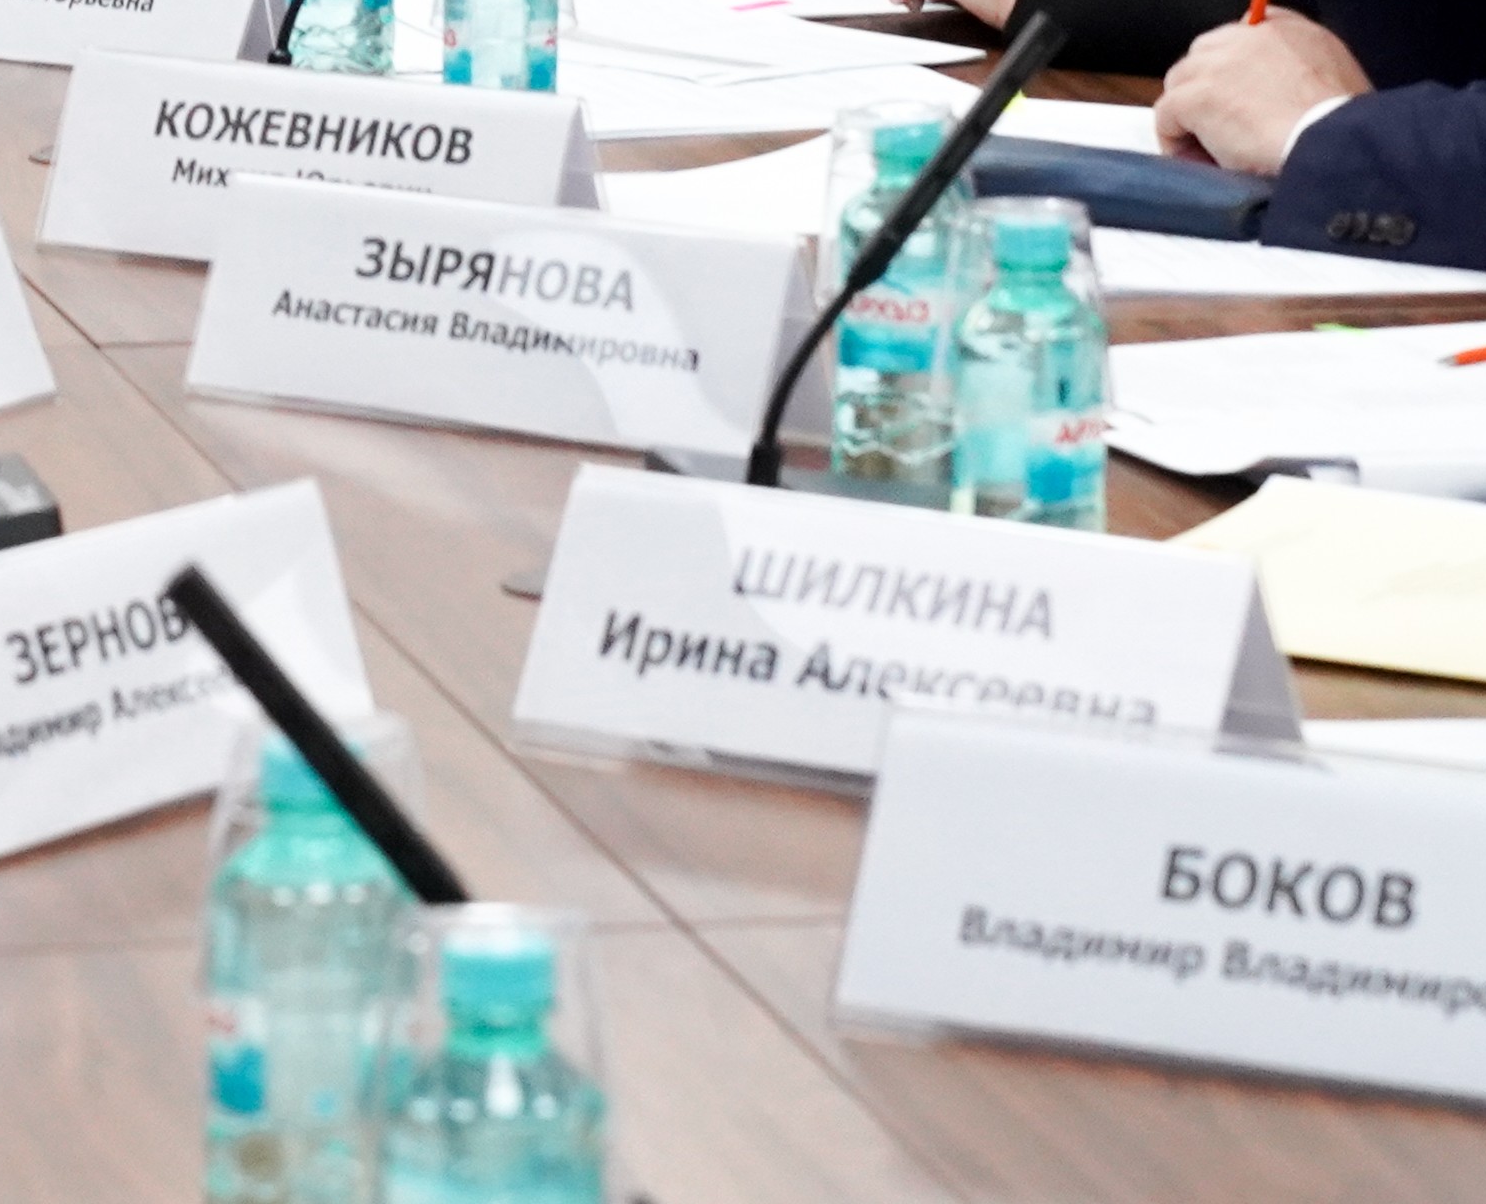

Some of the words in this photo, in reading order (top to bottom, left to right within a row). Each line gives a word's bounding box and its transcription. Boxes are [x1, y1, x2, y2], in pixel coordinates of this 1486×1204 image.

[154, 99, 474, 166] КОЖЕВНИКОВ
[355, 236, 636, 313] ЗЫРЯНОВА
[272, 289, 440, 335] Анастасия
[448, 310, 700, 373] Владимировна
[732, 546, 1056, 641] ШИЛКИНА
[5, 592, 193, 686] ЗЕРНОВ
[597, 608, 780, 682] Ирина
[1159, 843, 1418, 931] БОКОВ
[957, 903, 1208, 981] Владимир
